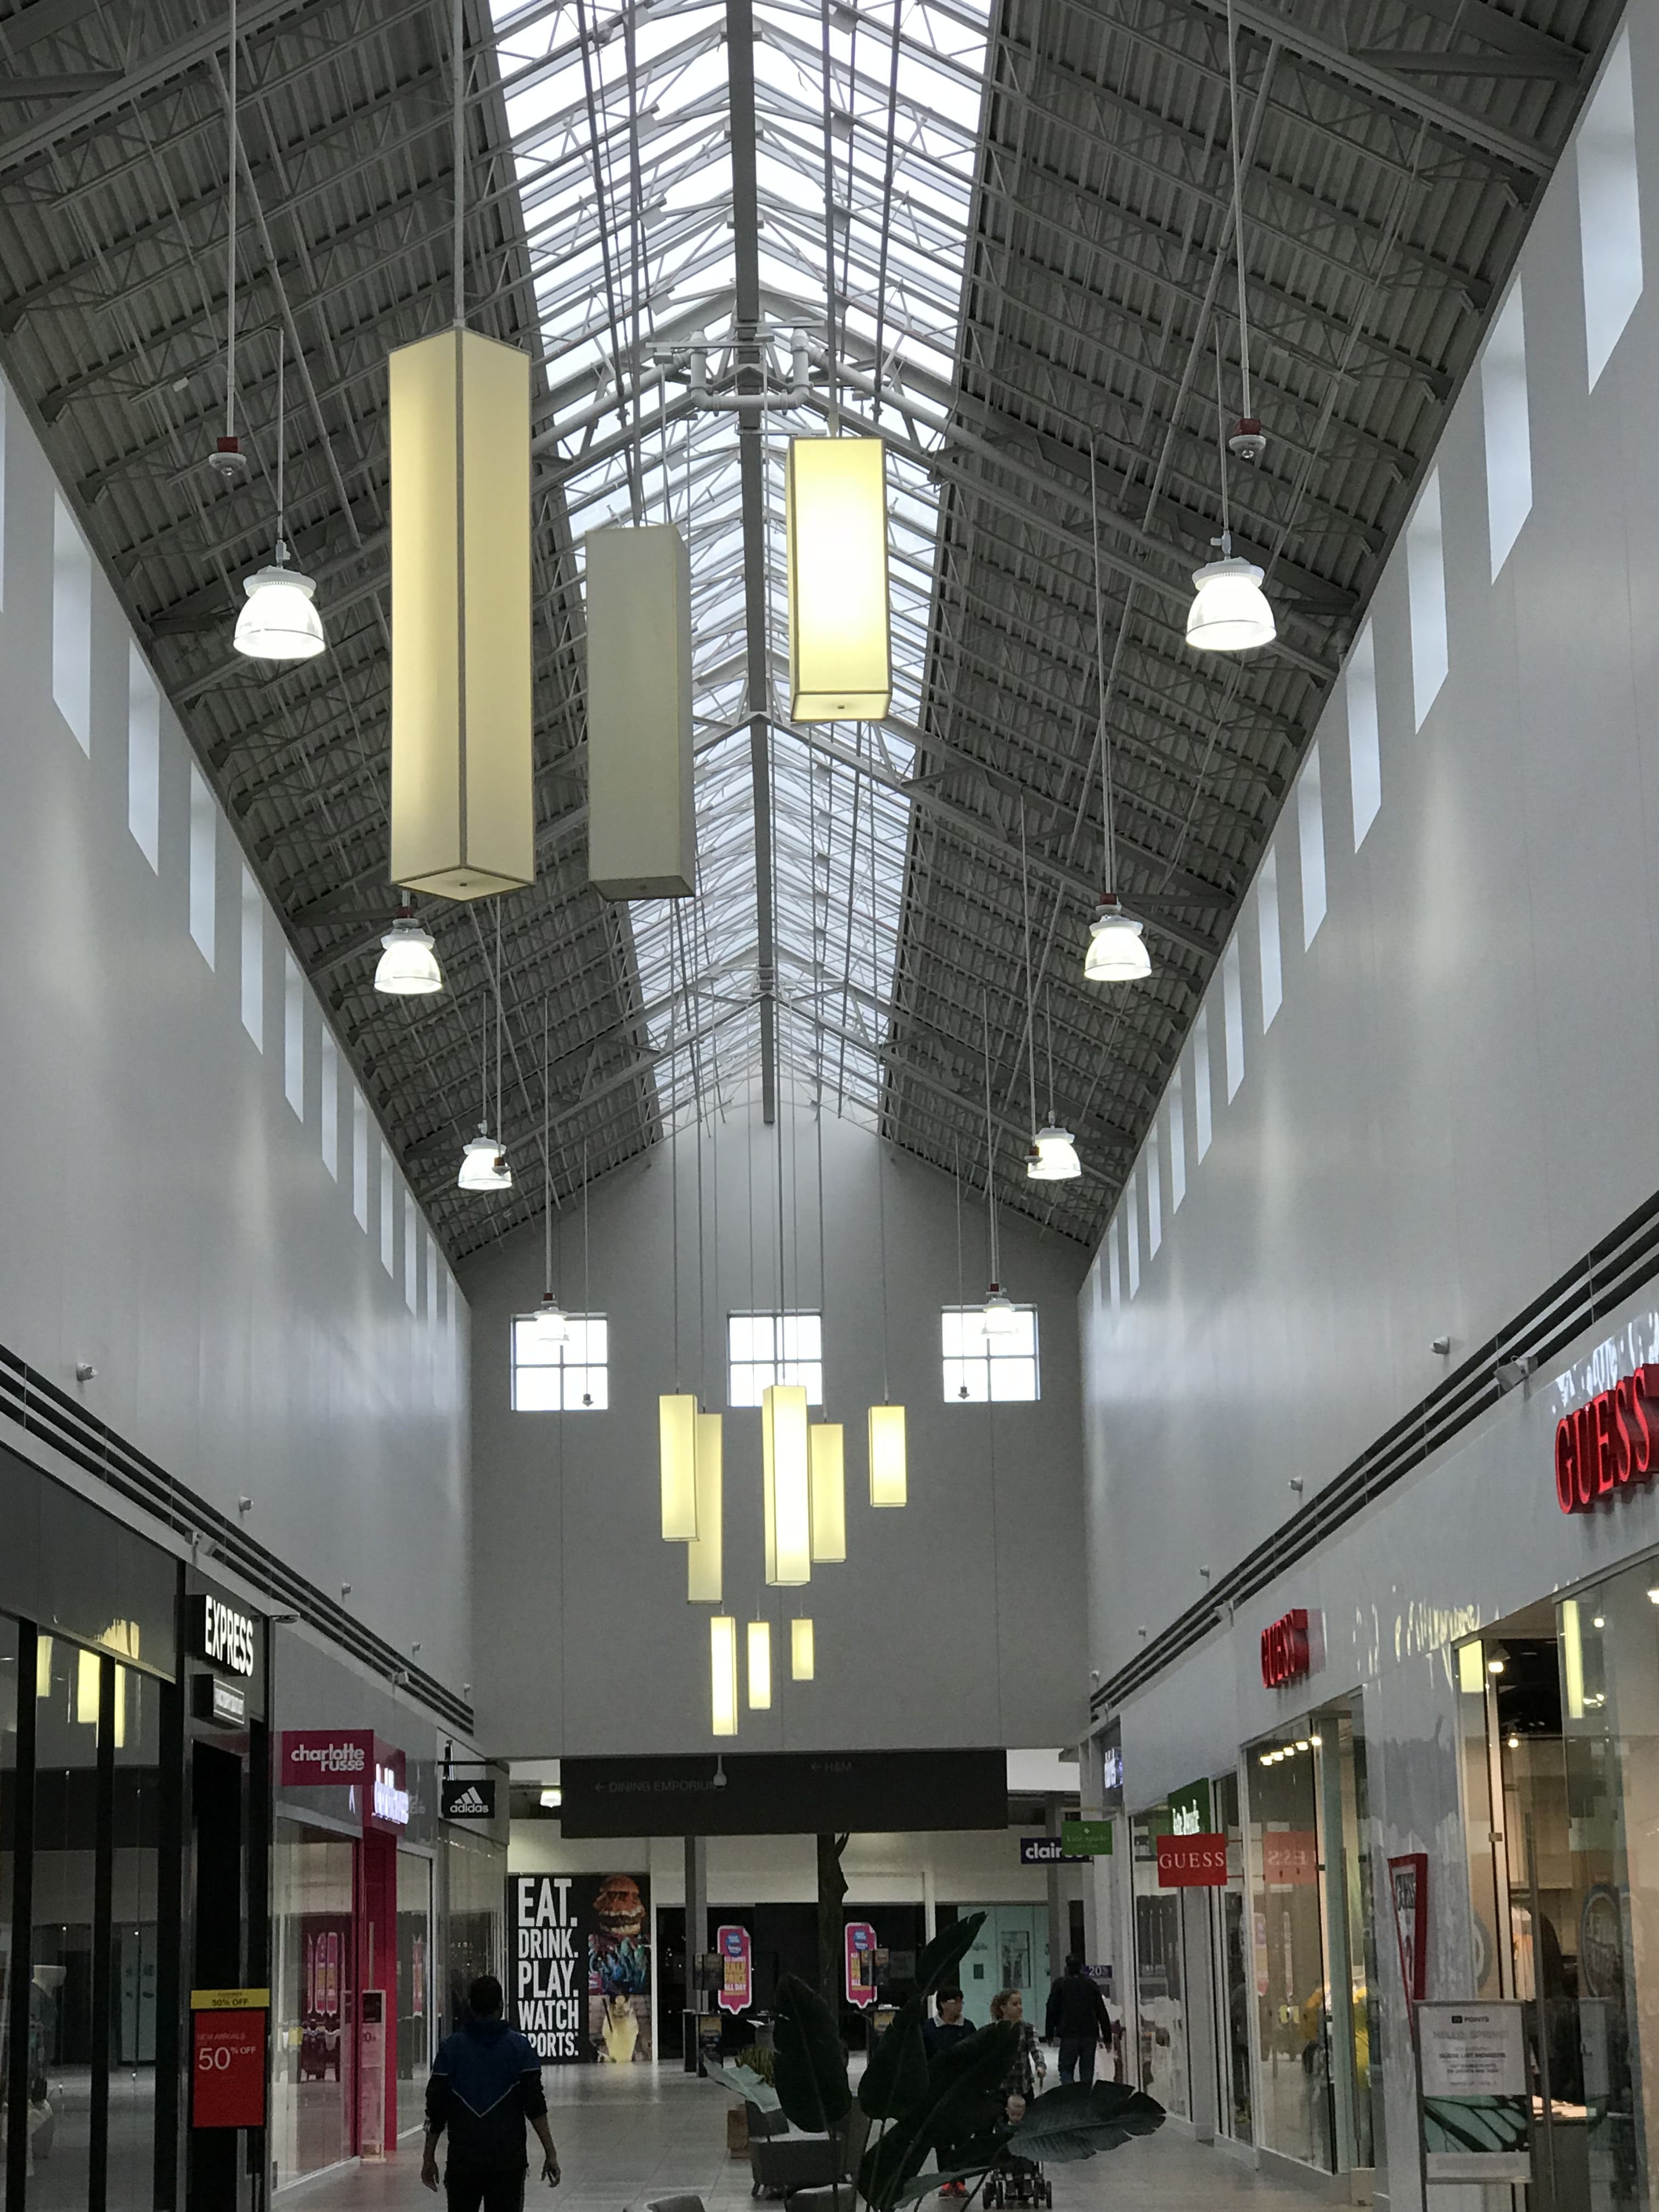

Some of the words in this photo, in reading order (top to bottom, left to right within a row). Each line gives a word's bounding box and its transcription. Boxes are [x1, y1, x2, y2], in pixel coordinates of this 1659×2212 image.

[1555, 1366, 1651, 1514] GUESS
[205, 1595, 253, 1677] EXPRESS
[291, 1743, 365, 1761] charlotte
[321, 1759, 365, 1771] russe
[609, 1782, 650, 1792] DINING
[450, 1804, 489, 1813] adidas
[1025, 1842, 1084, 1859] clair
[1159, 1852, 1224, 1869] GUESS
[518, 1878, 577, 1927] EAT.
[518, 1928, 578, 1959] DRINK.
[518, 1960, 579, 1998] PLAY.
[518, 2000, 579, 2030] WATCH
[527, 2032, 579, 2057] PORTS.
